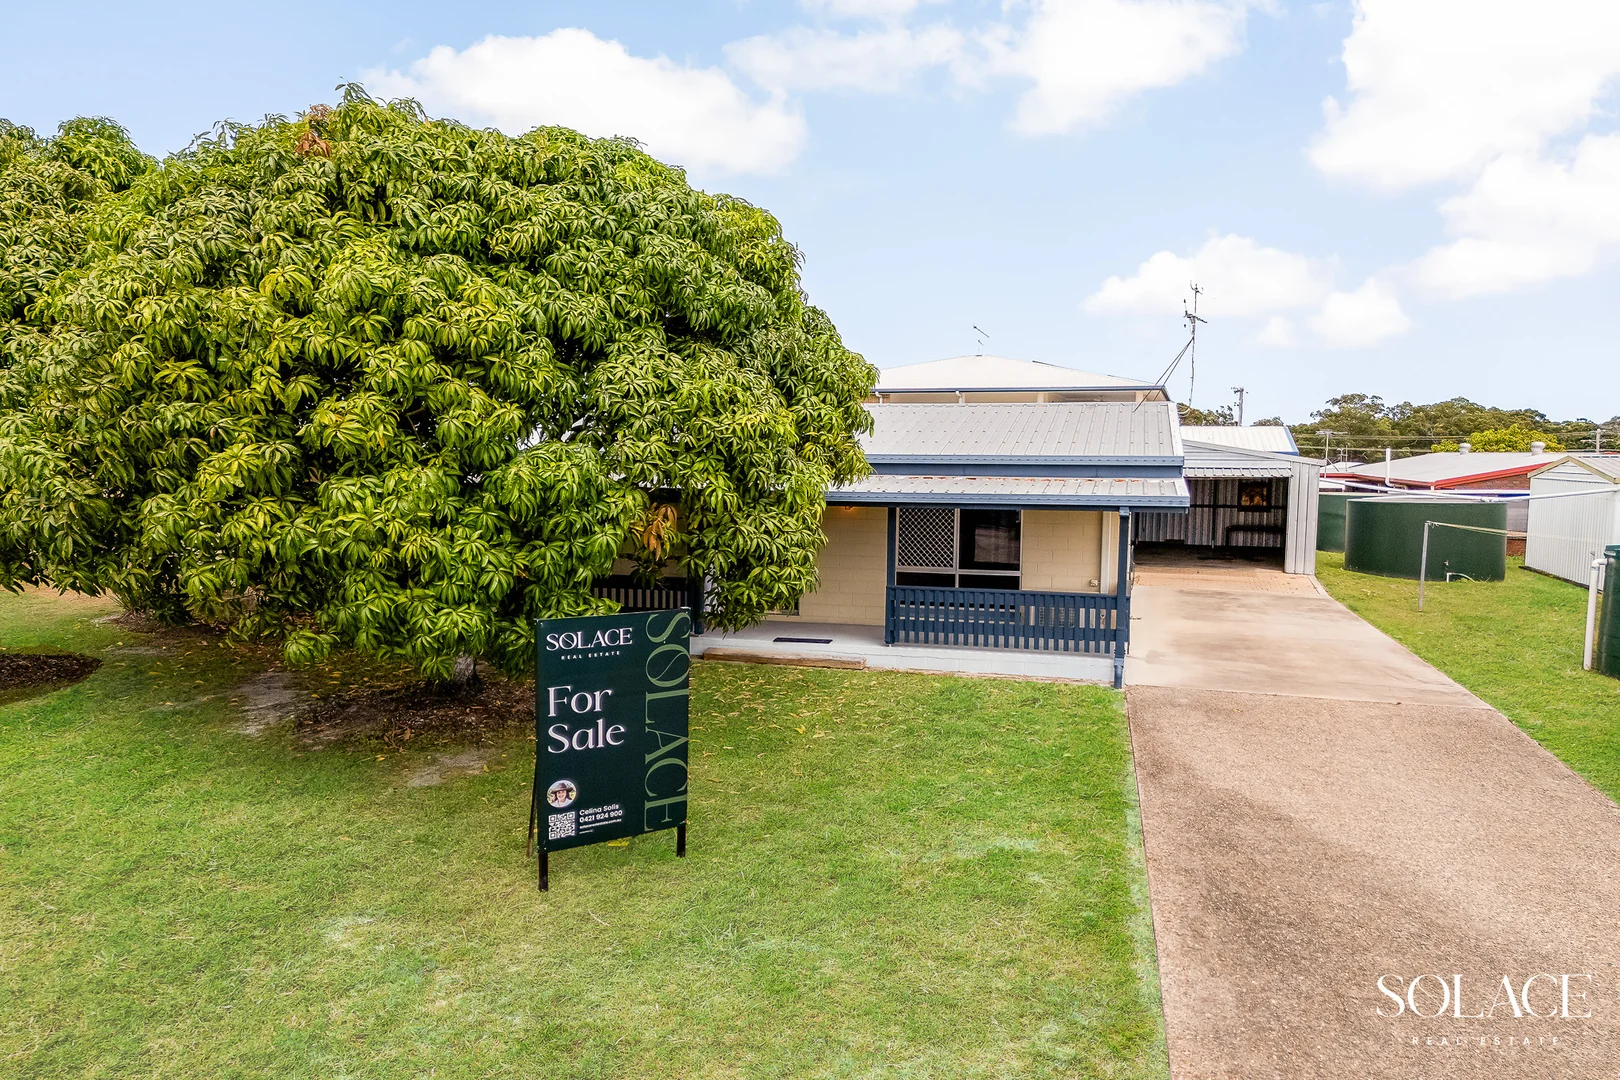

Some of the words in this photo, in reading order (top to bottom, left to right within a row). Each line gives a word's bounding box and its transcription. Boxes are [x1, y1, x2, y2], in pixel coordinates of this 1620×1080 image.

[546, 627, 633, 651] SOLACE
[588, 650, 620, 658] ESTATE
[547, 686, 612, 717] For
[644, 611, 691, 832] SOLACE
[547, 718, 626, 754] Sale
[579, 807, 602, 816] Celina
[603, 804, 619, 812] Solis
[579, 815, 595, 823] 0421
[596, 812, 609, 820] 924
